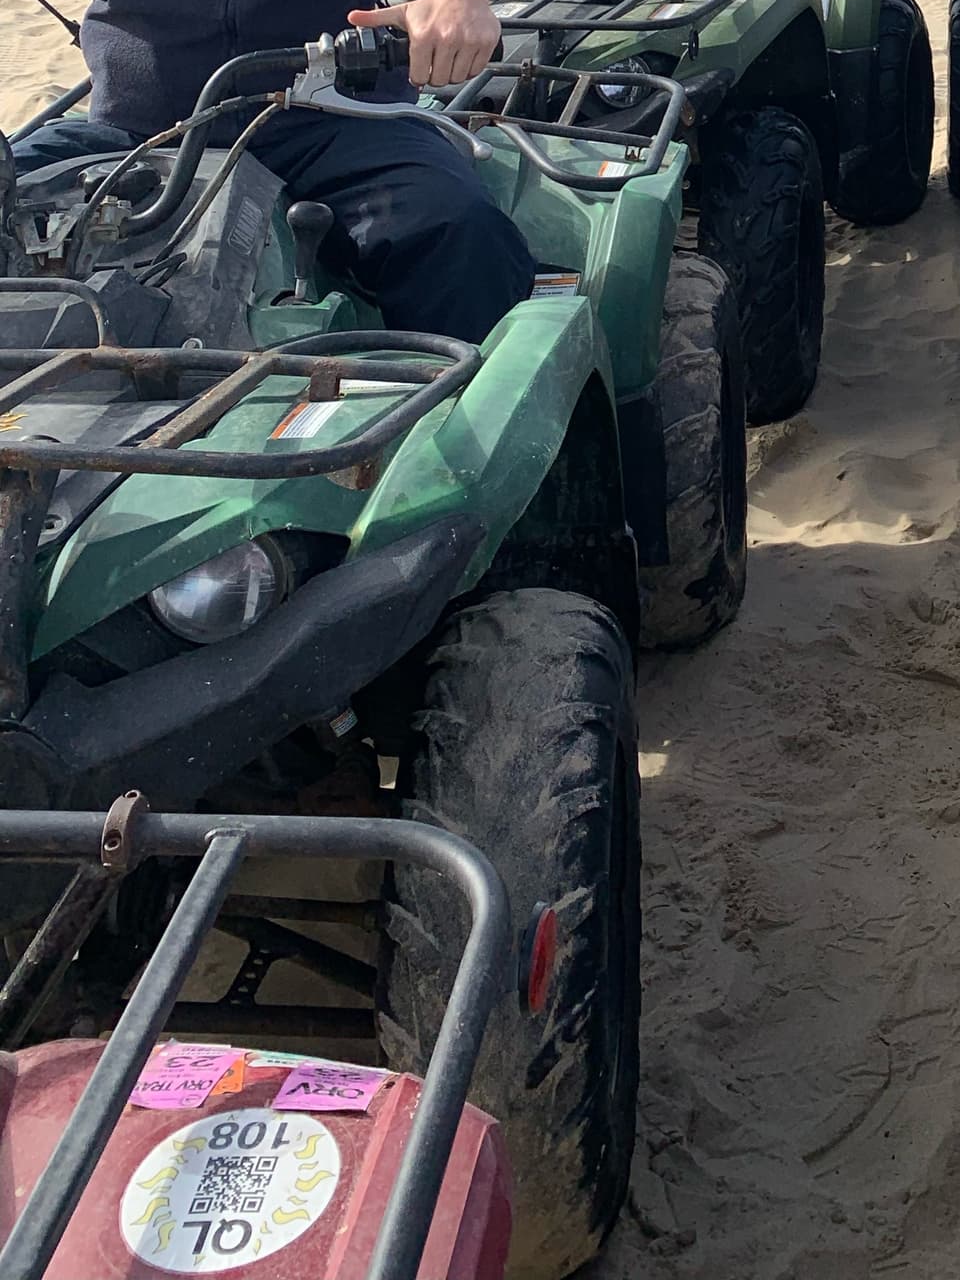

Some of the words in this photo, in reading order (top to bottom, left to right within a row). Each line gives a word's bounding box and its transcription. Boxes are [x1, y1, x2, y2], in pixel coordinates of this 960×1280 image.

[175, 1079, 214, 1091] ORV
[286, 1081, 365, 1099] ORV
[209, 1120, 291, 1151] 108
[182, 1220, 254, 1256] QL
